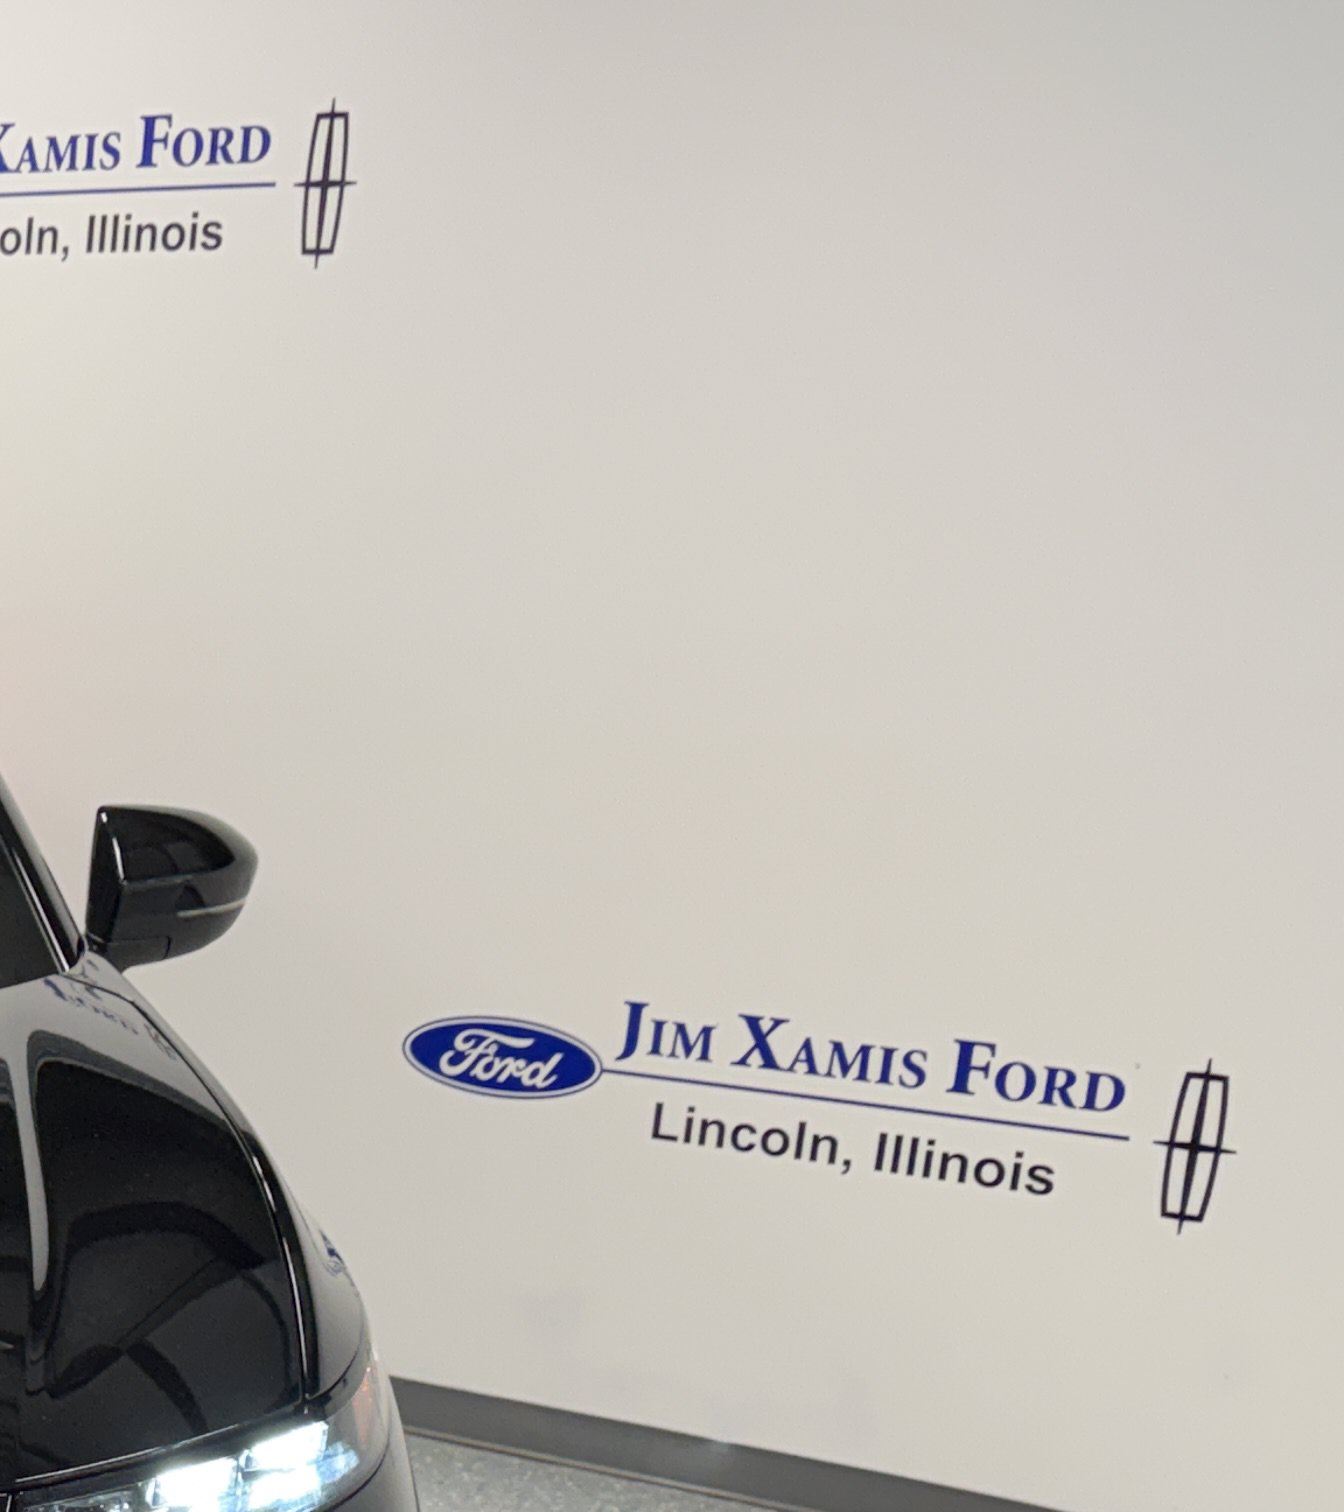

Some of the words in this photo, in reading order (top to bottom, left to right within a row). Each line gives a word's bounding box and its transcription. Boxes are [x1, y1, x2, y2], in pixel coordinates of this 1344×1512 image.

[136, 114, 270, 168] FORD
[86, 212, 223, 254] Illinois
[439, 1029, 560, 1091] Ford
[616, 1001, 717, 1063] JIM
[731, 1014, 928, 1089] XAMIS
[946, 1039, 1126, 1113] FORD
[651, 1103, 853, 1176] Lincoln,
[873, 1133, 1055, 1196] Illinois
